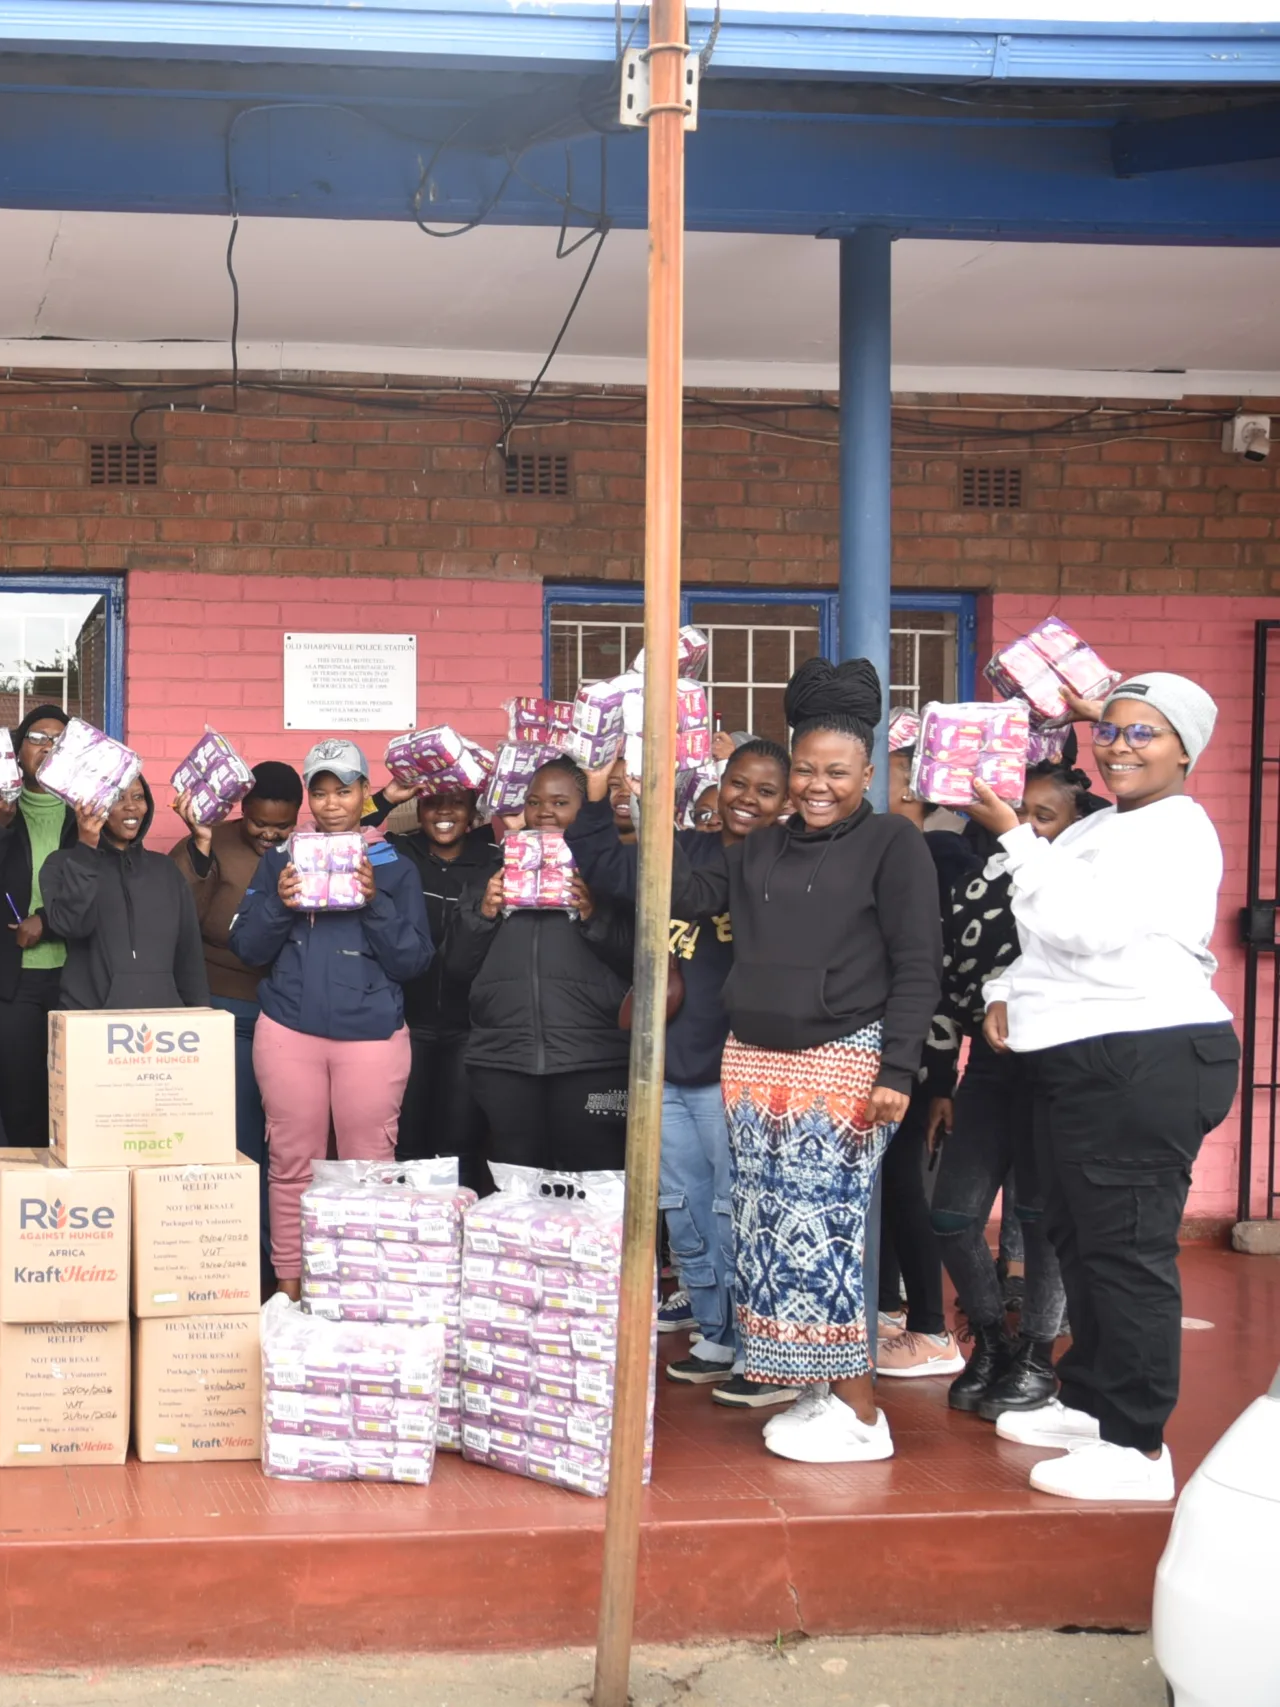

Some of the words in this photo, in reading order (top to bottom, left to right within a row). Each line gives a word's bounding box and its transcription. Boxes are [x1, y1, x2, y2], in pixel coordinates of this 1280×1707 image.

[107, 1056, 152, 1065] AGAINST
[156, 1055, 200, 1064] HUNGER
[136, 1073, 172, 1081] AFRICA
[124, 1136, 173, 1153] mpact
[182, 1183, 219, 1191] RELIEF
[20, 1232, 64, 1240] AGAINST
[69, 1232, 114, 1240] HUNGER
[48, 1249, 85, 1257] AFRICA
[14, 1264, 118, 1284] KraftHeinz
[24, 1325, 109, 1334] HUMANITARIAN
[165, 1322, 248, 1331] HUMANITARIAN
